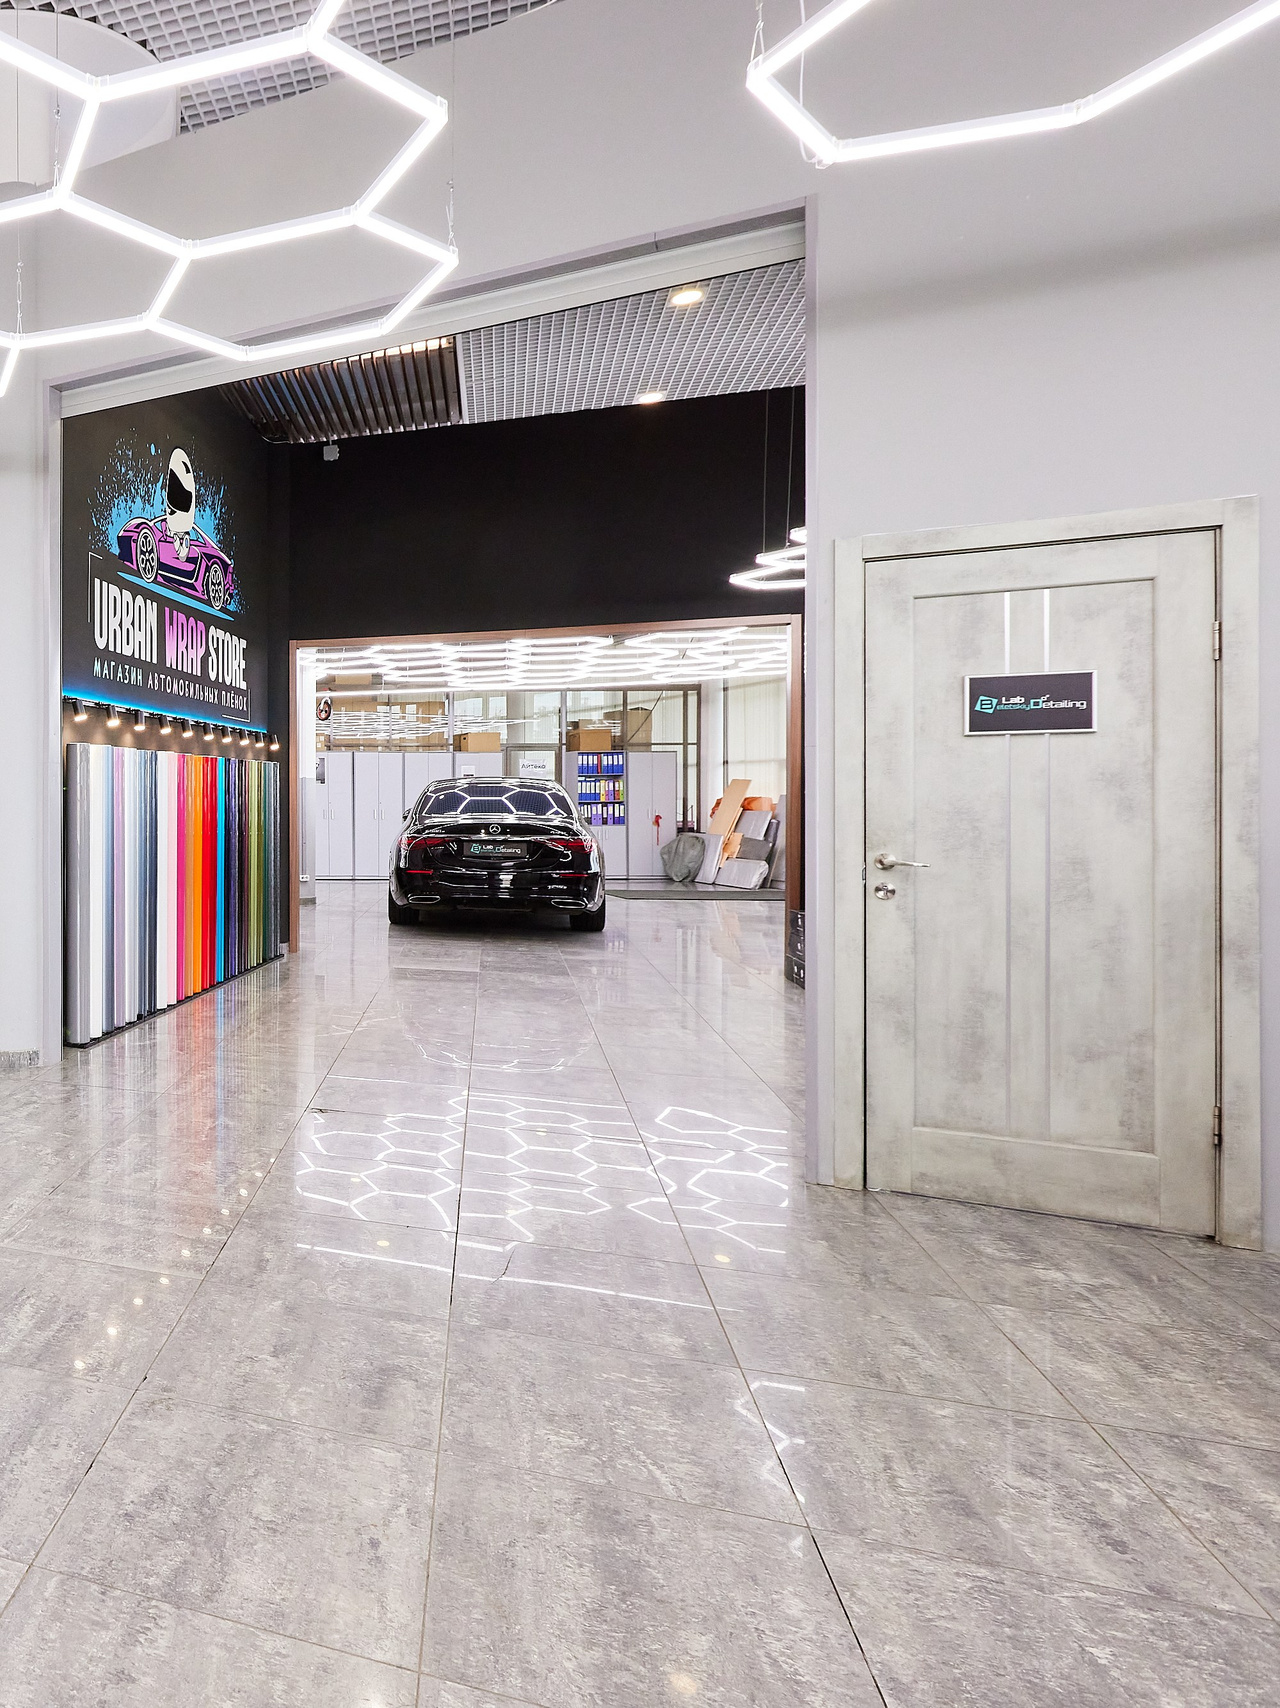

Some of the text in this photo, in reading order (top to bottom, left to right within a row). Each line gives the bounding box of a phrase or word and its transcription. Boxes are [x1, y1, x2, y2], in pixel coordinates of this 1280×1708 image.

[94, 577, 247, 690] URBAN WRAP STORE
[93, 657, 248, 711] МАГАЗИН АВТОМОБИЛЬНЫХ ПЛЁНОК
[1001, 696, 1025, 704] Lab
[1030, 697, 1087, 710] Detailing
